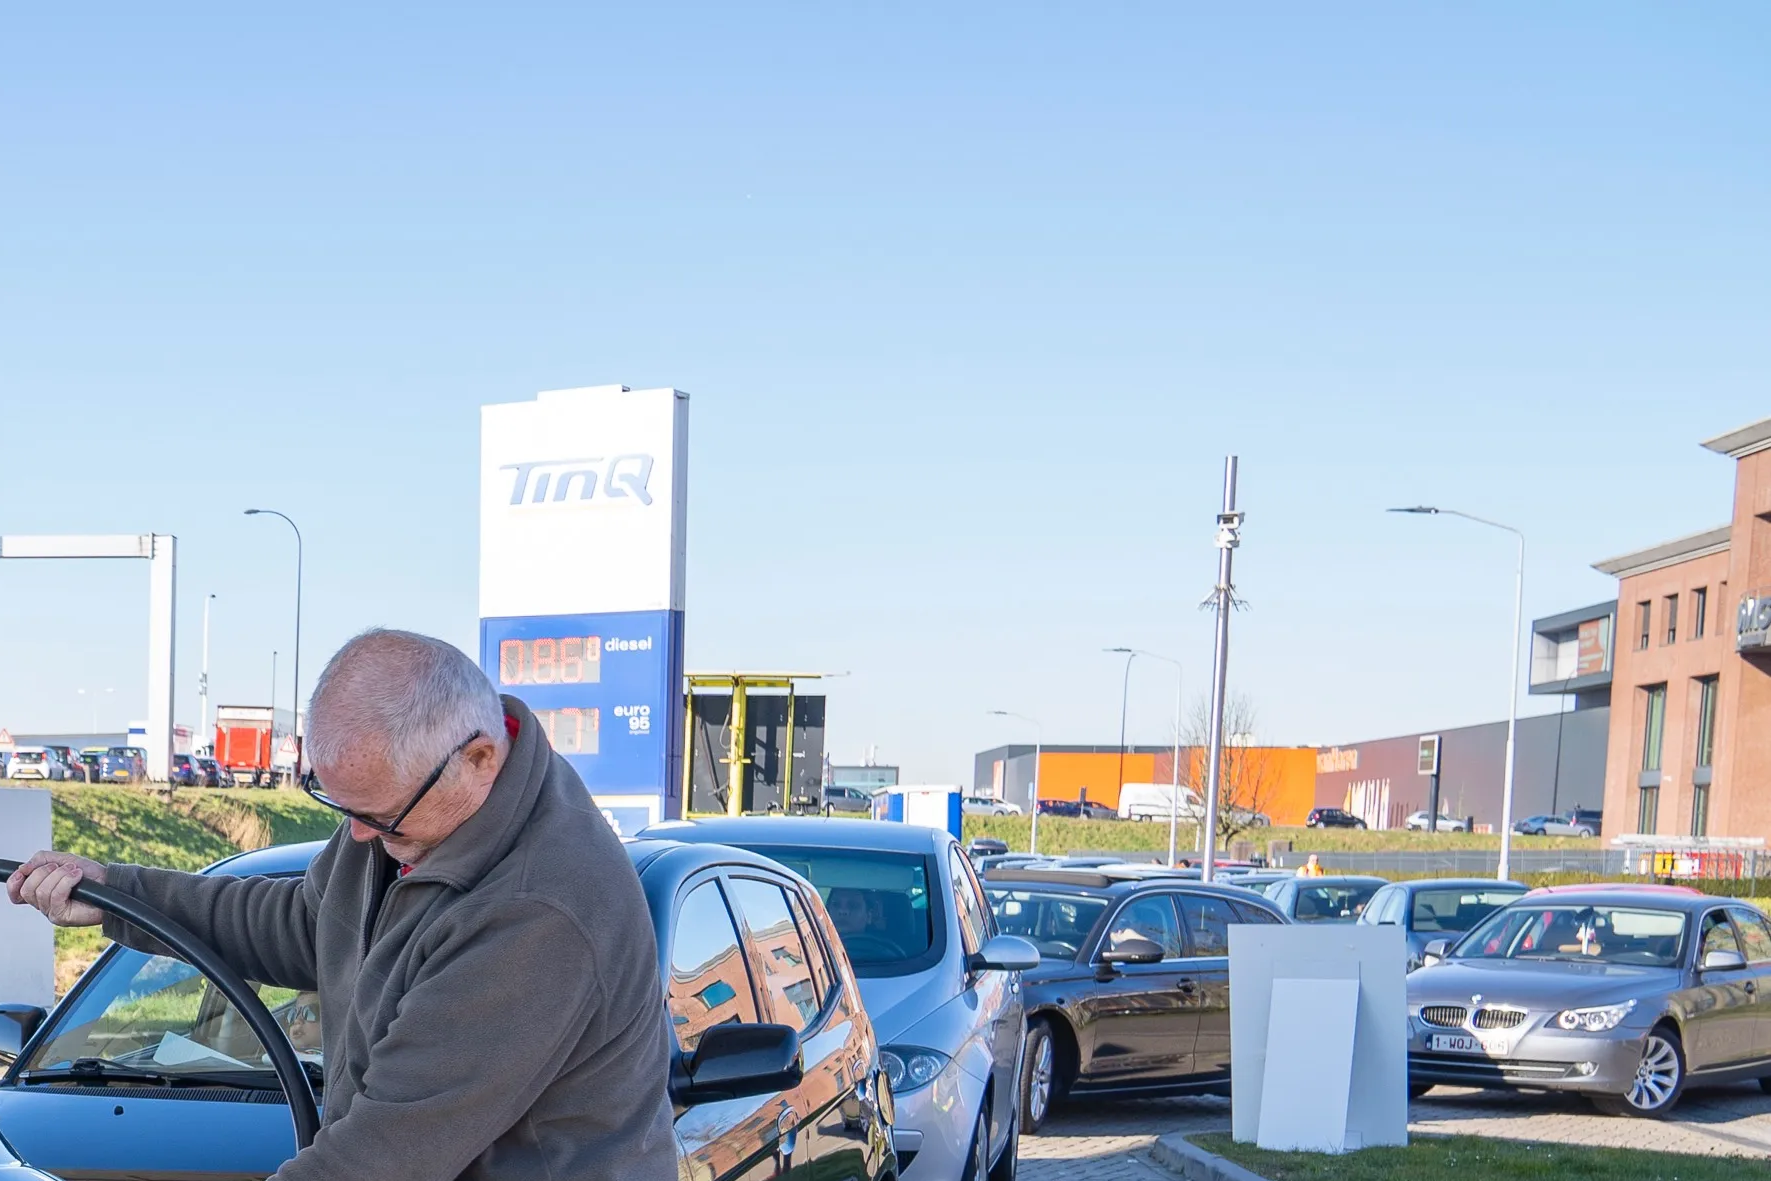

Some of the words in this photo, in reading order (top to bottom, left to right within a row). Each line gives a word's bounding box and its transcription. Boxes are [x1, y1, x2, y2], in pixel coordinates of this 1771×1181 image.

[604, 636, 653, 652] diesel
[614, 705, 651, 717] euro
[629, 716, 651, 730] 95
